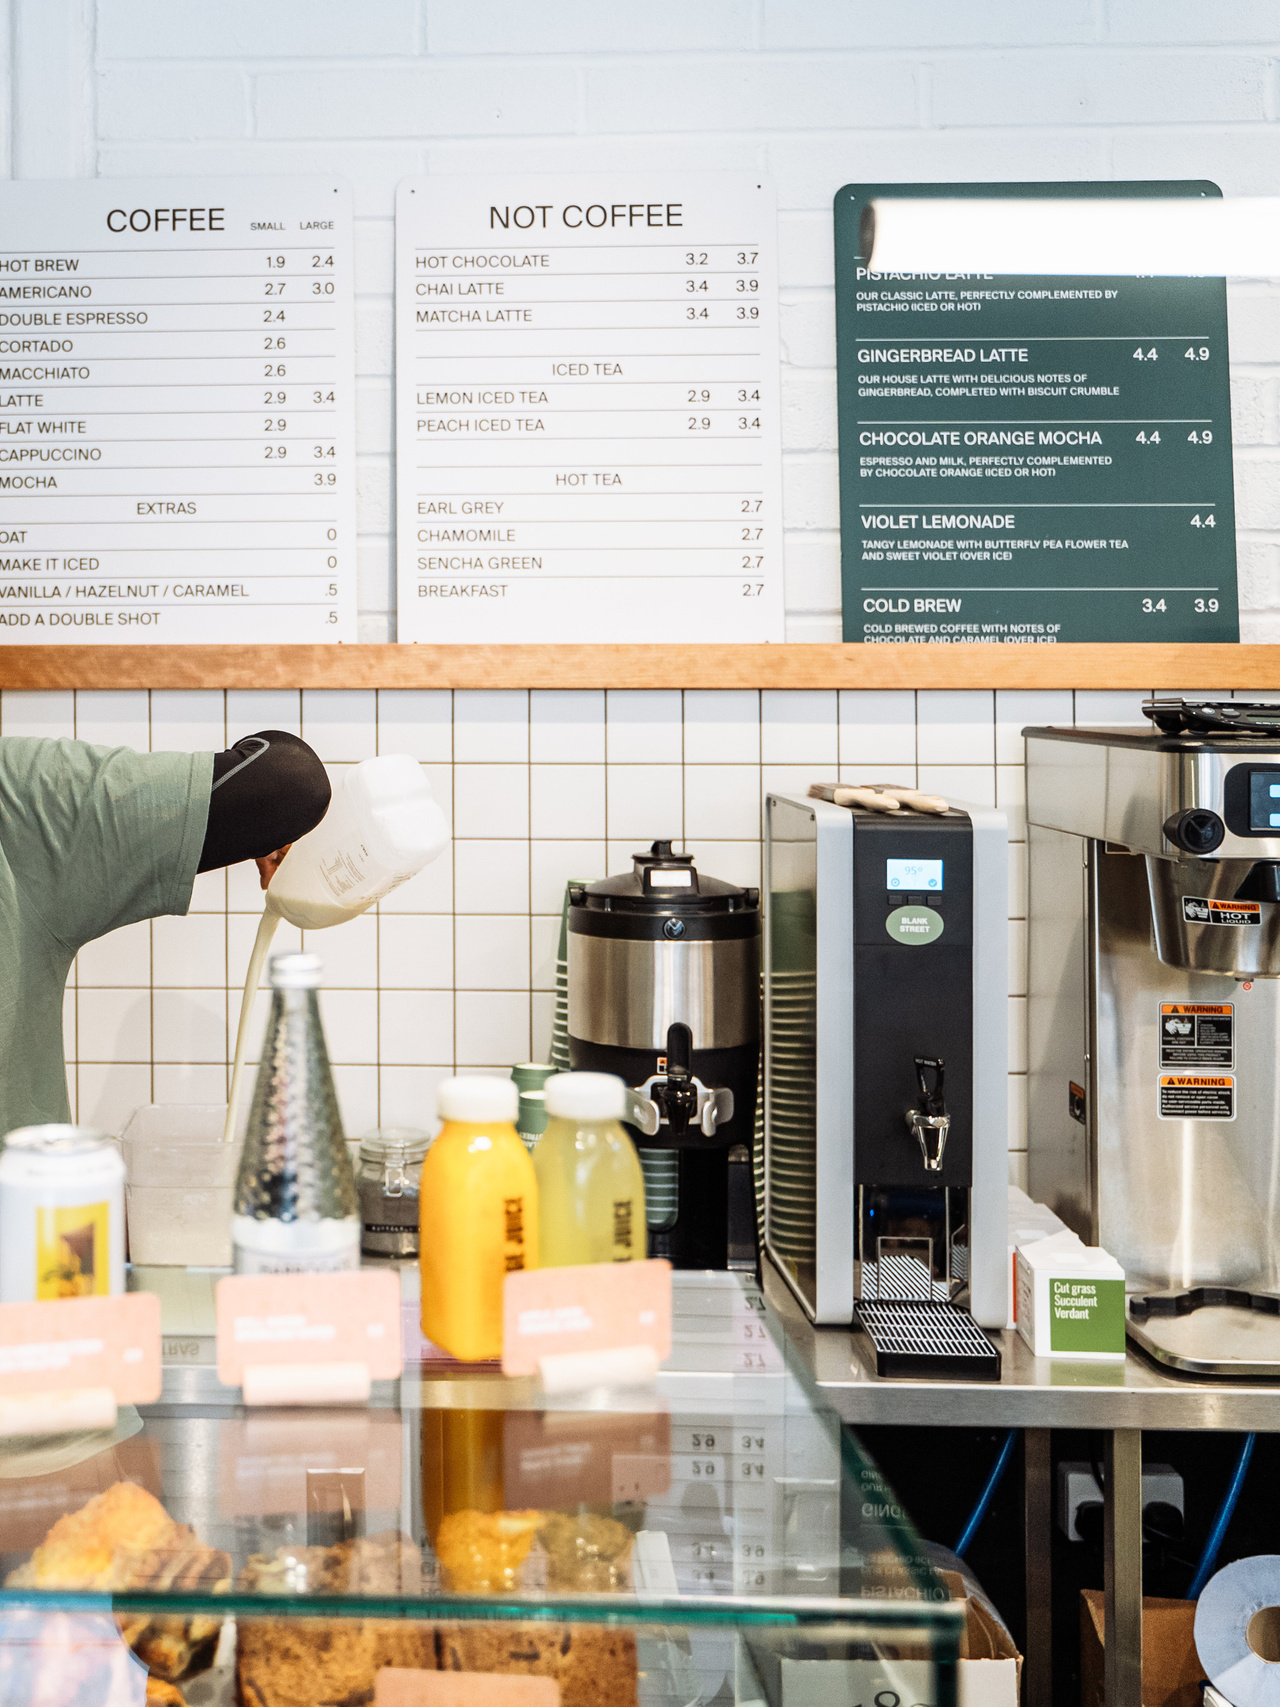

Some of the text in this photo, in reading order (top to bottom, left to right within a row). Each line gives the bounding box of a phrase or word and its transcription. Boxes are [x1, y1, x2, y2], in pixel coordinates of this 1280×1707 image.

[107, 208, 224, 232] COFFEE
[491, 204, 682, 229] NOT COFFEE
[300, 221, 333, 230] LARGE
[0, 259, 79, 272] HOT BREW
[416, 255, 549, 268] HOT CHOCOLATE
[416, 283, 504, 296] CHAI LATTE
[856, 290, 1118, 300] OUR CLASSIC LATTE, PERFECTLY COMPLEMENTED BY
[857, 302, 981, 311] PISTACHIO (ICED OR HOT)
[67, 312, 148, 325] ESPRESSO
[417, 310, 532, 322] MATCHA LATTE
[858, 347, 1209, 362] GINGERBREAD LATTE 4.4 4.9
[553, 364, 623, 376] ICED TEA
[858, 374, 1087, 384] OUR HOUSE LATTE WITH DELICIOUS NOTES OF
[858, 387, 1119, 396] GINGERBREAD, COMPLETED WITH BISCUIT CRUMBLE
[417, 392, 548, 404] LEMON ICED TEA
[37, 421, 86, 433] WHITE
[417, 419, 544, 432] PEACH ICED TEA
[860, 431, 1212, 445] CHOCOLATE ORANGE MOCHA 4.4 4.9
[860, 456, 1112, 465] ESPRESSO AND MILK, PERFECTLY COMPLEMENTED
[860, 468, 1055, 477] BY CHOCOLATE ORANGE (ICED OR HOT)
[556, 474, 622, 486] HOT TEA
[137, 502, 196, 515] EXTRAS
[418, 502, 503, 514] EARL GREY
[861, 514, 1216, 529] VIOLET LEMONADE 4.4
[417, 529, 515, 542] CHAMOMILE
[862, 540, 1128, 549] TANGY LEMONADE WITH BUTTERFLY PEA FLOWER TEA
[862, 552, 1012, 560] AND SWEET VIOLET (OVER ICE)
[47, 558, 59, 570] IT
[64, 558, 99, 570] ICED
[418, 557, 542, 570] SENCHA GREEN
[76, 585, 158, 597] HAZELNUT
[173, 585, 248, 597] CARAMEL
[418, 585, 508, 597] BREAKFAST
[864, 599, 1218, 612] COLD BREW 3.4 3.9
[35, 614, 45, 625] A
[50, 613, 113, 625] DOUBLE
[118, 613, 160, 625] SHOT
[864, 624, 1060, 633] COLD BREWED COFFEE WITH NOTES OF
[1220, 903, 1257, 911] WARNING
[901, 917, 928, 925] BLANK
[1220, 912, 1251, 920] HOT
[900, 925, 931, 933] STREET
[1183, 1006, 1223, 1014] WARNING
[1177, 1077, 1226, 1086] WARNING
[1053, 1281, 1097, 1296] Cut grass
[1053, 1294, 1098, 1307] Succulent
[1054, 1307, 1090, 1320] Verdant
